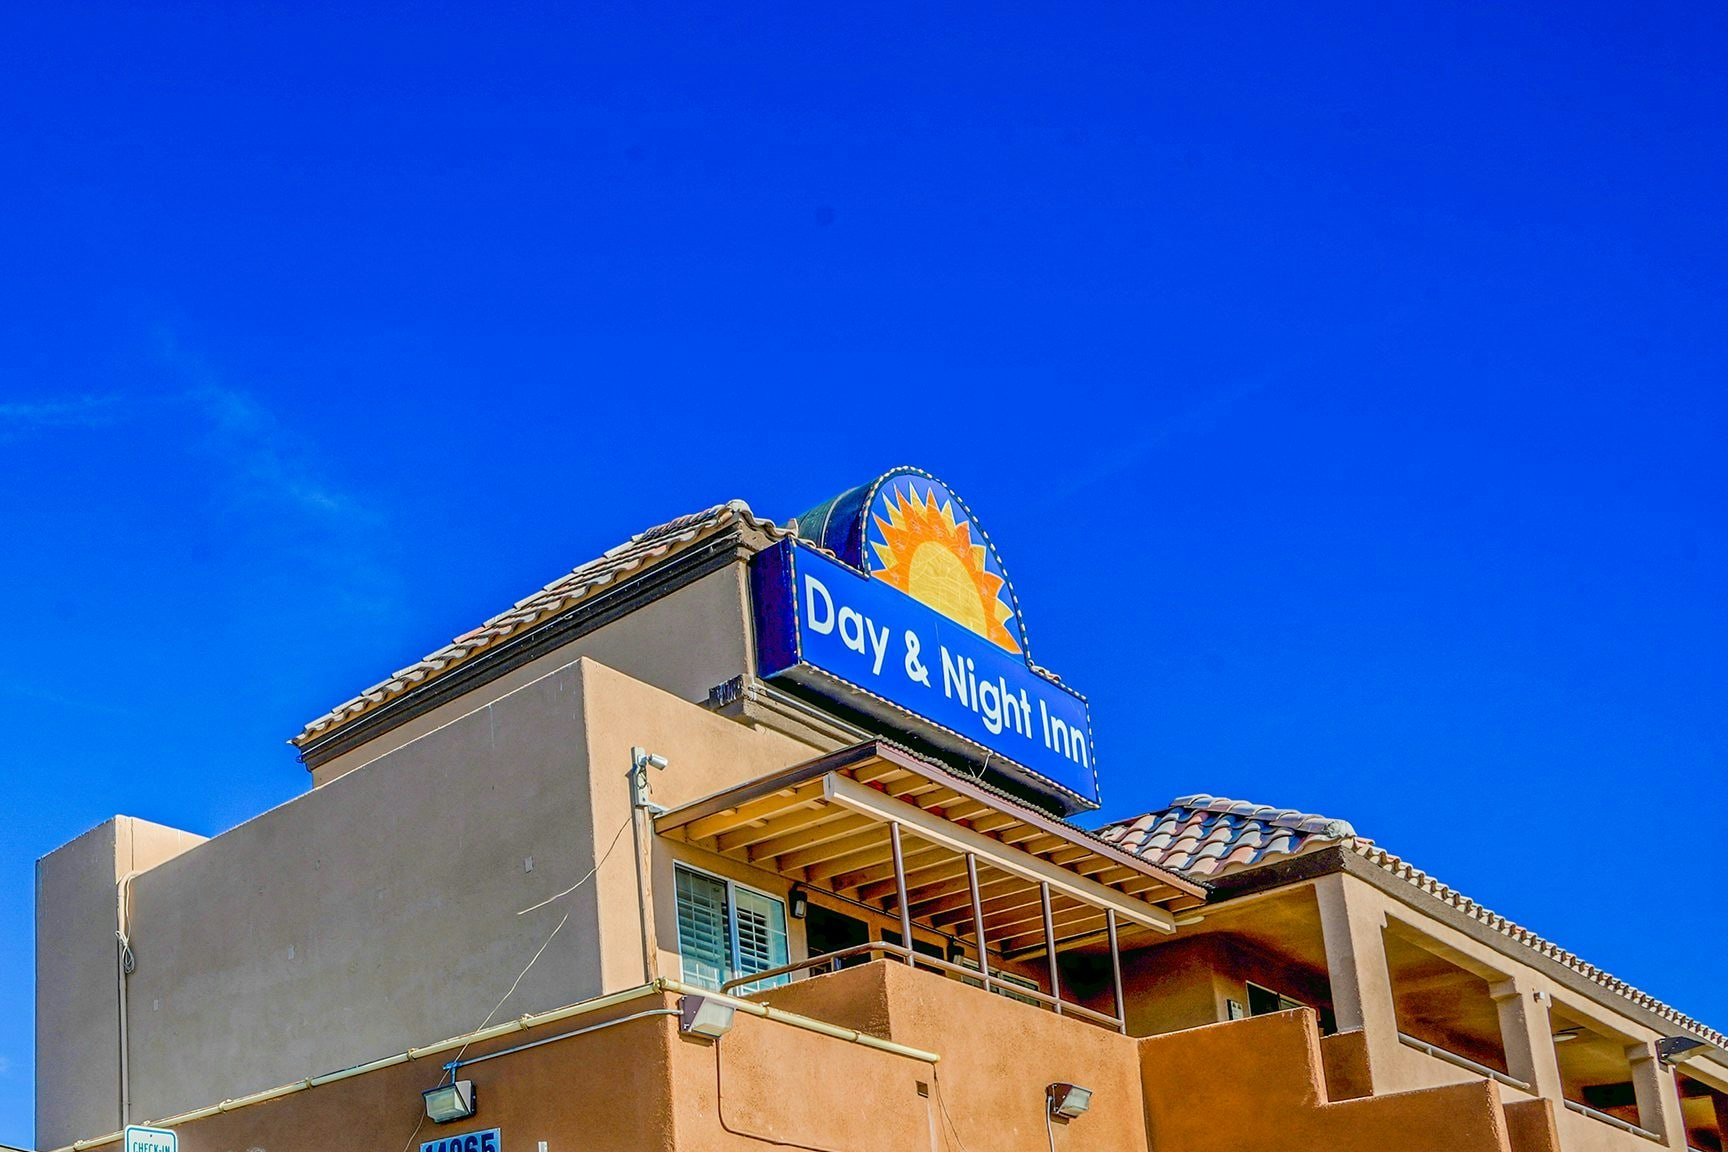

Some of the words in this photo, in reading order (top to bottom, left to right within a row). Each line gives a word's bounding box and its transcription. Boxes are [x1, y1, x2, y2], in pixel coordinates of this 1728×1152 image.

[804, 573, 889, 676] Day
[904, 629, 932, 689] &
[940, 645, 1032, 740] Night
[1039, 699, 1089, 768] Inn
